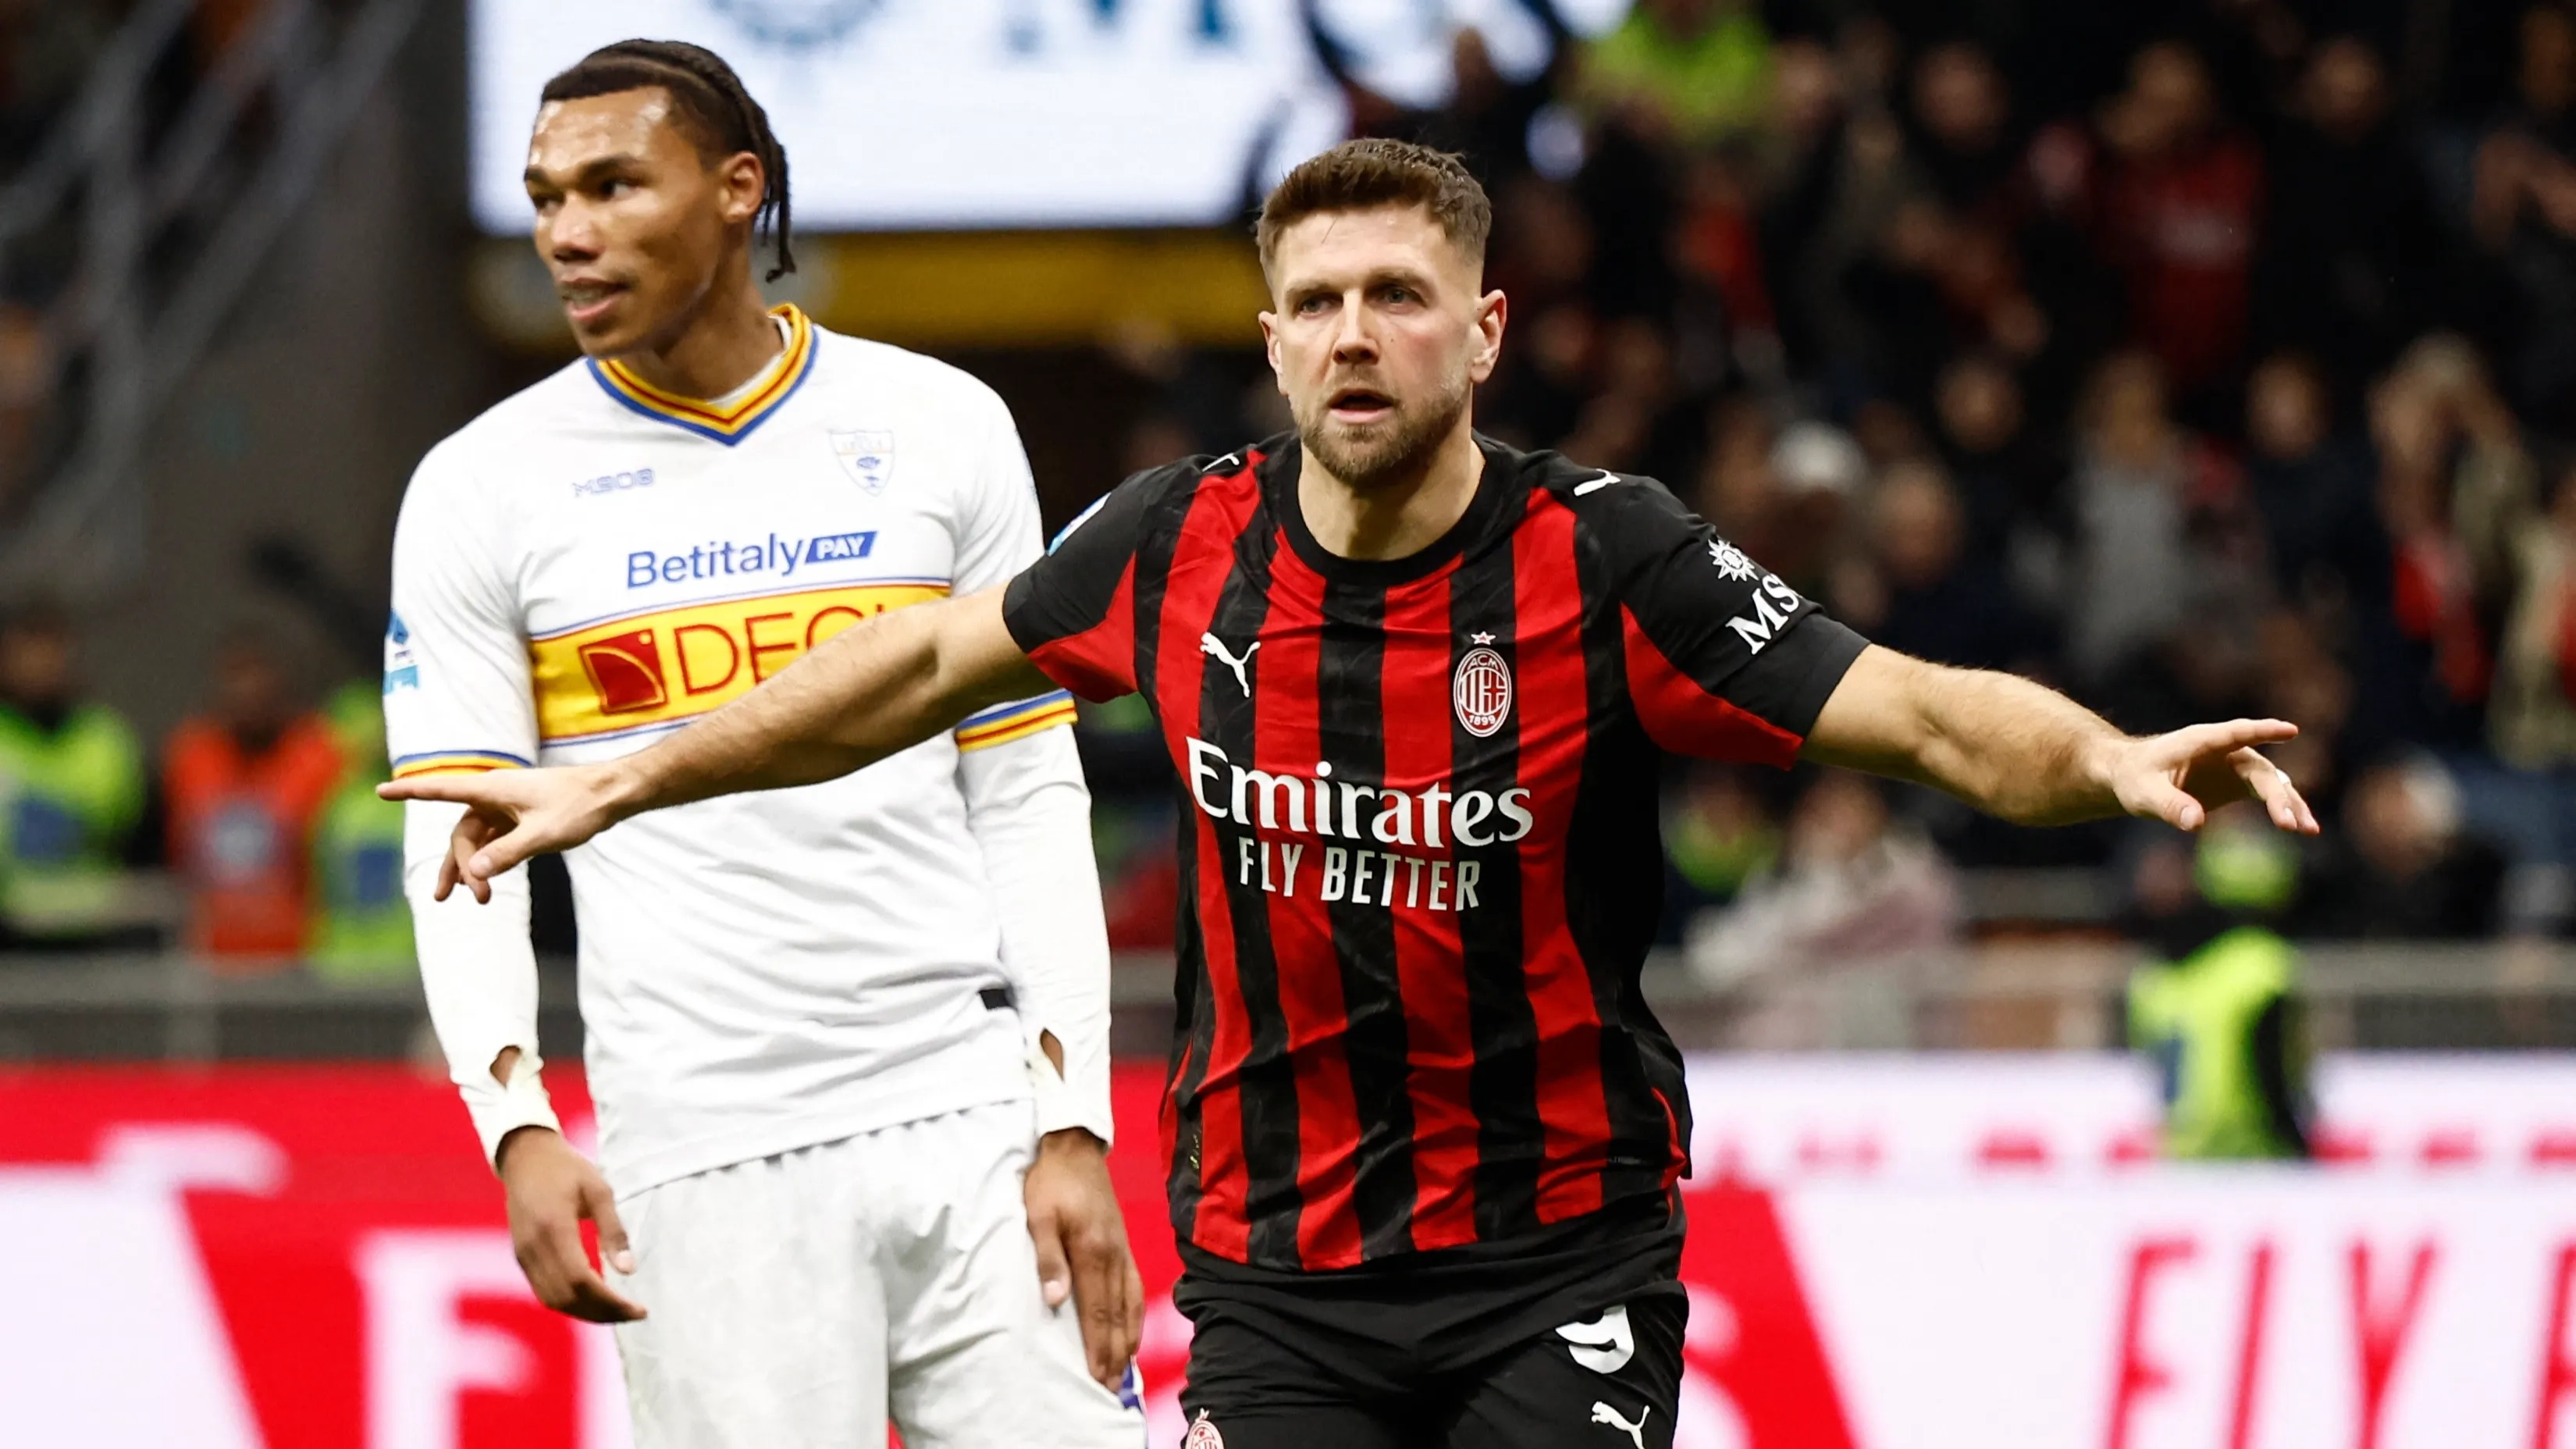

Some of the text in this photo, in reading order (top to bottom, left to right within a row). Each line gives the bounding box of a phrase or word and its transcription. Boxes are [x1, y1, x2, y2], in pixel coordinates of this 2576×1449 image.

[627, 532, 867, 589] Betitaly PAY
[1724, 572, 1802, 655] MS
[1468, 654, 1499, 671] ACM
[1468, 714, 1496, 726] 1899
[1186, 736, 1533, 848] Emirates
[1238, 837, 1481, 912] FLY BETTER
[1555, 1303, 1635, 1375] 9
